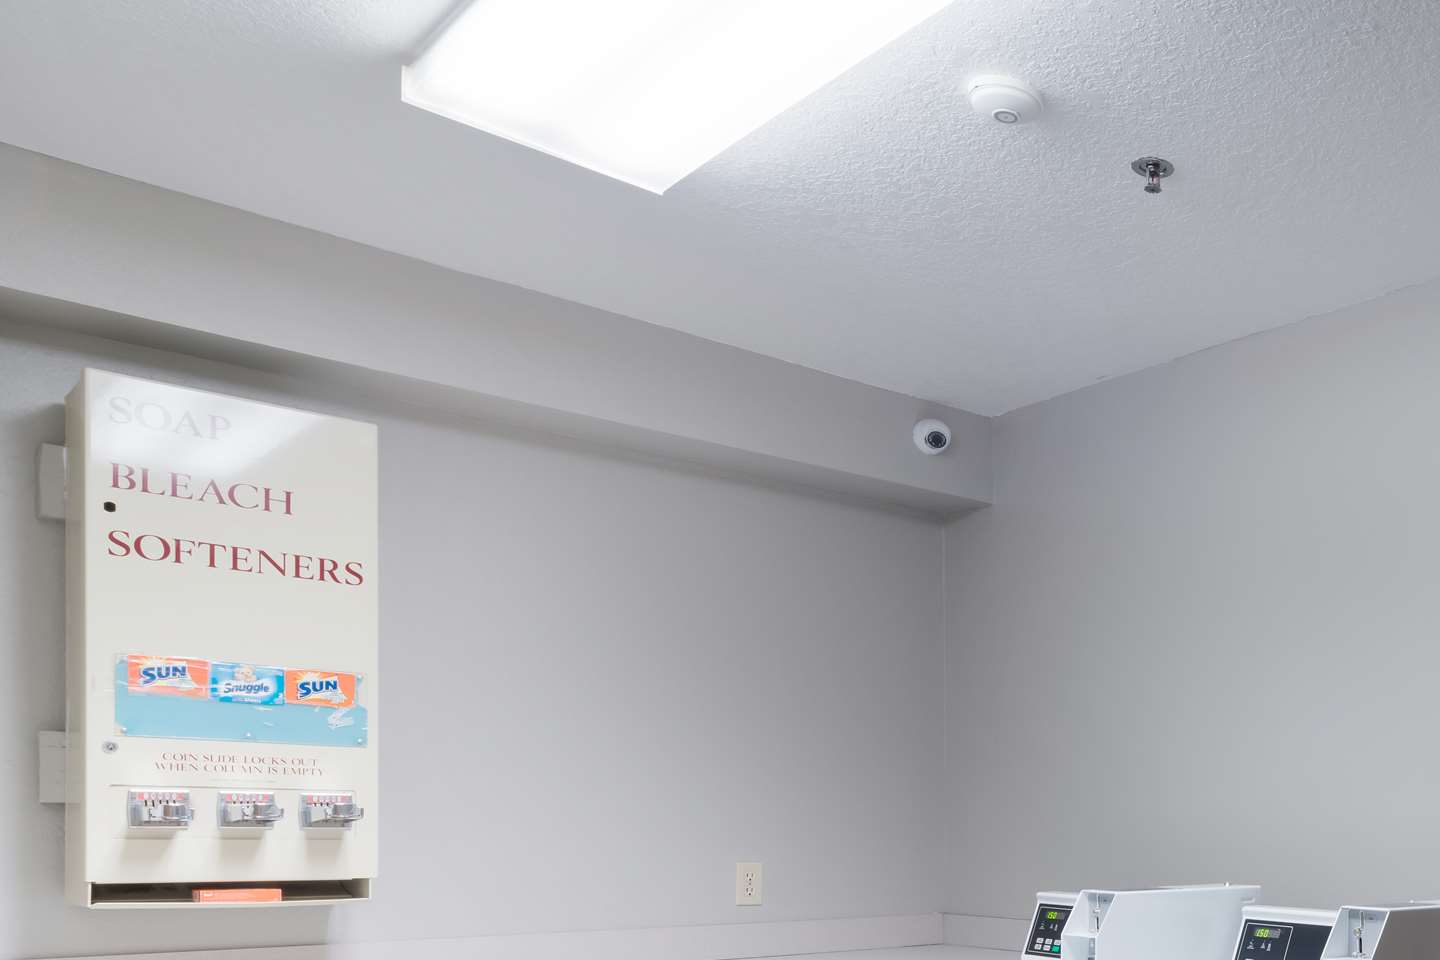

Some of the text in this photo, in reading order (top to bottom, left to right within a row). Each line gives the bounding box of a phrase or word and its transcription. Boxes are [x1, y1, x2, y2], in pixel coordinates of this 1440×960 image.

[108, 396, 232, 441] SOAP
[110, 461, 293, 515] BLEACH
[107, 529, 364, 587] SOFTENERS
[142, 665, 186, 685] SUN
[223, 683, 269, 695] Snuggle
[299, 679, 338, 697] SUN
[162, 752, 317, 766] COIN SLIDE LOCKS OUT
[153, 762, 323, 776] WHEN COLUMN IS EMPTY
